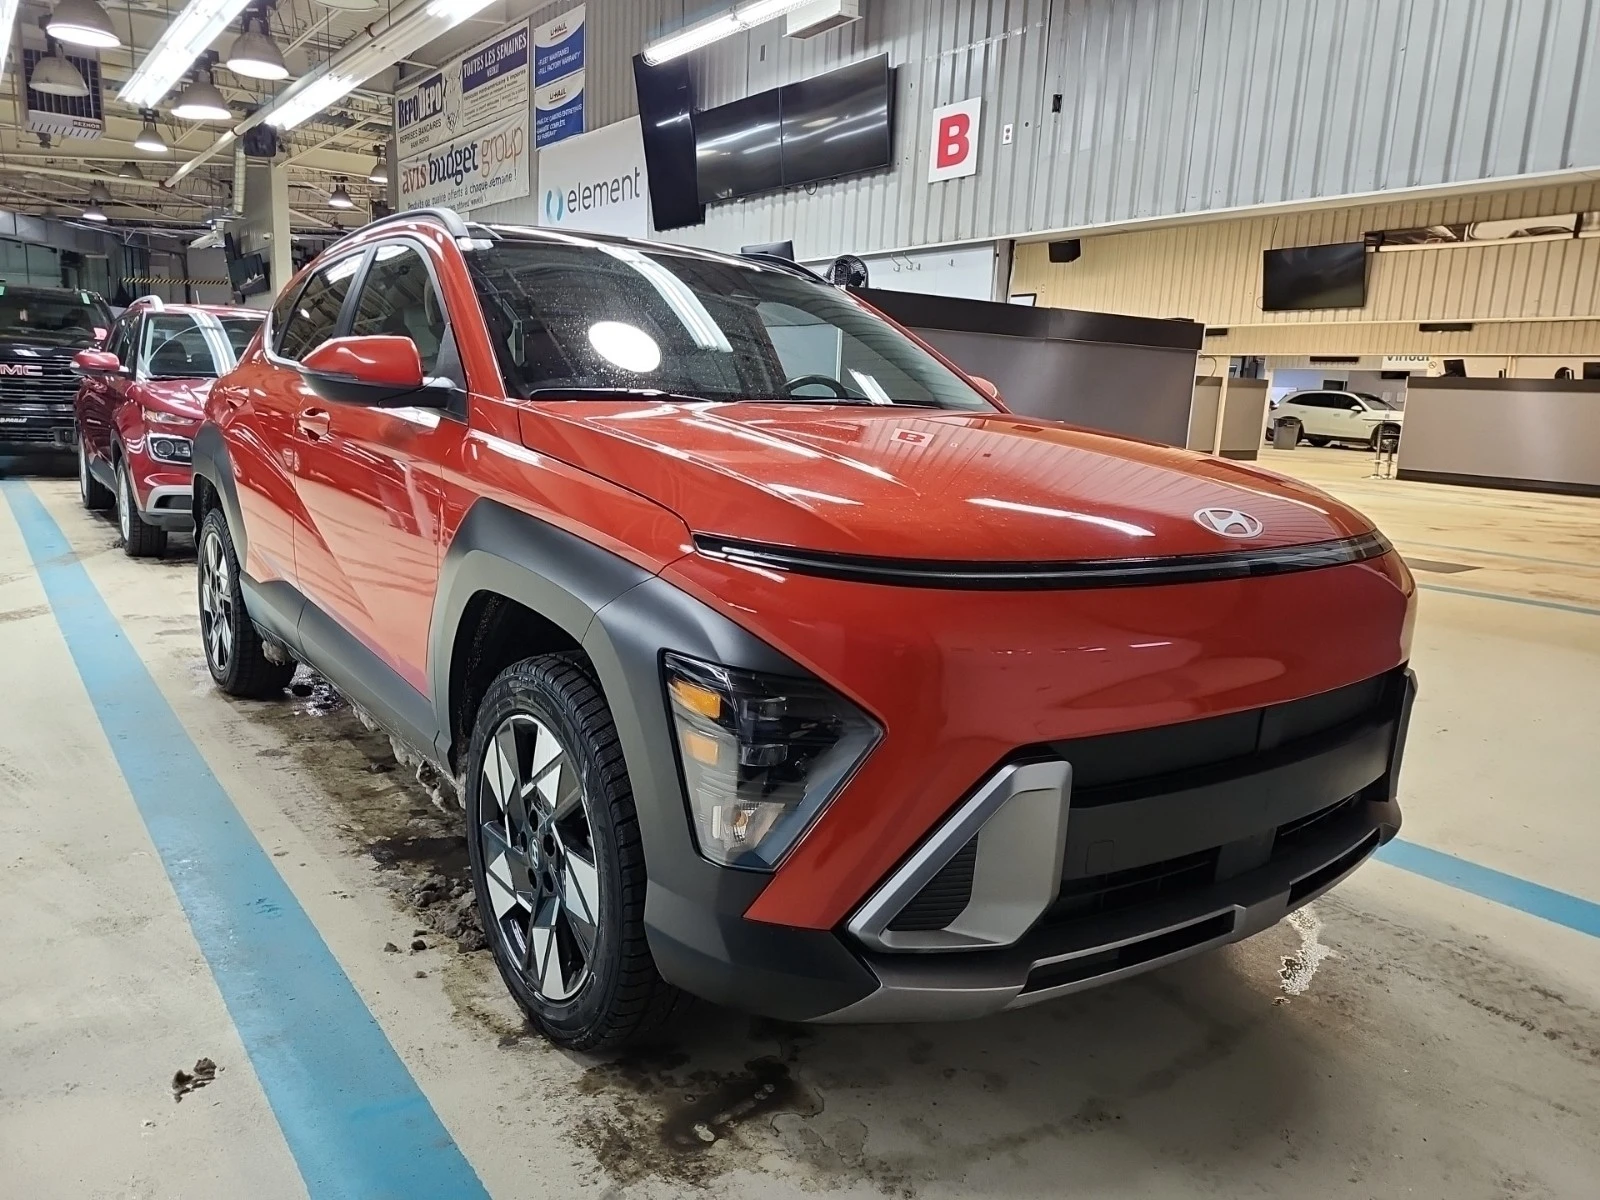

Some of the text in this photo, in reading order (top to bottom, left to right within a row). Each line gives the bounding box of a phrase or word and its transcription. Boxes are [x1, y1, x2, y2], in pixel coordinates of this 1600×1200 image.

[463, 32, 527, 79] TOUTES LES SEMAINES
[402, 126, 524, 195] avis budget group
[936, 113, 970, 169] B
[470, 181, 488, 194] chaque
[489, 171, 513, 188] semaine
[567, 166, 641, 214] element
